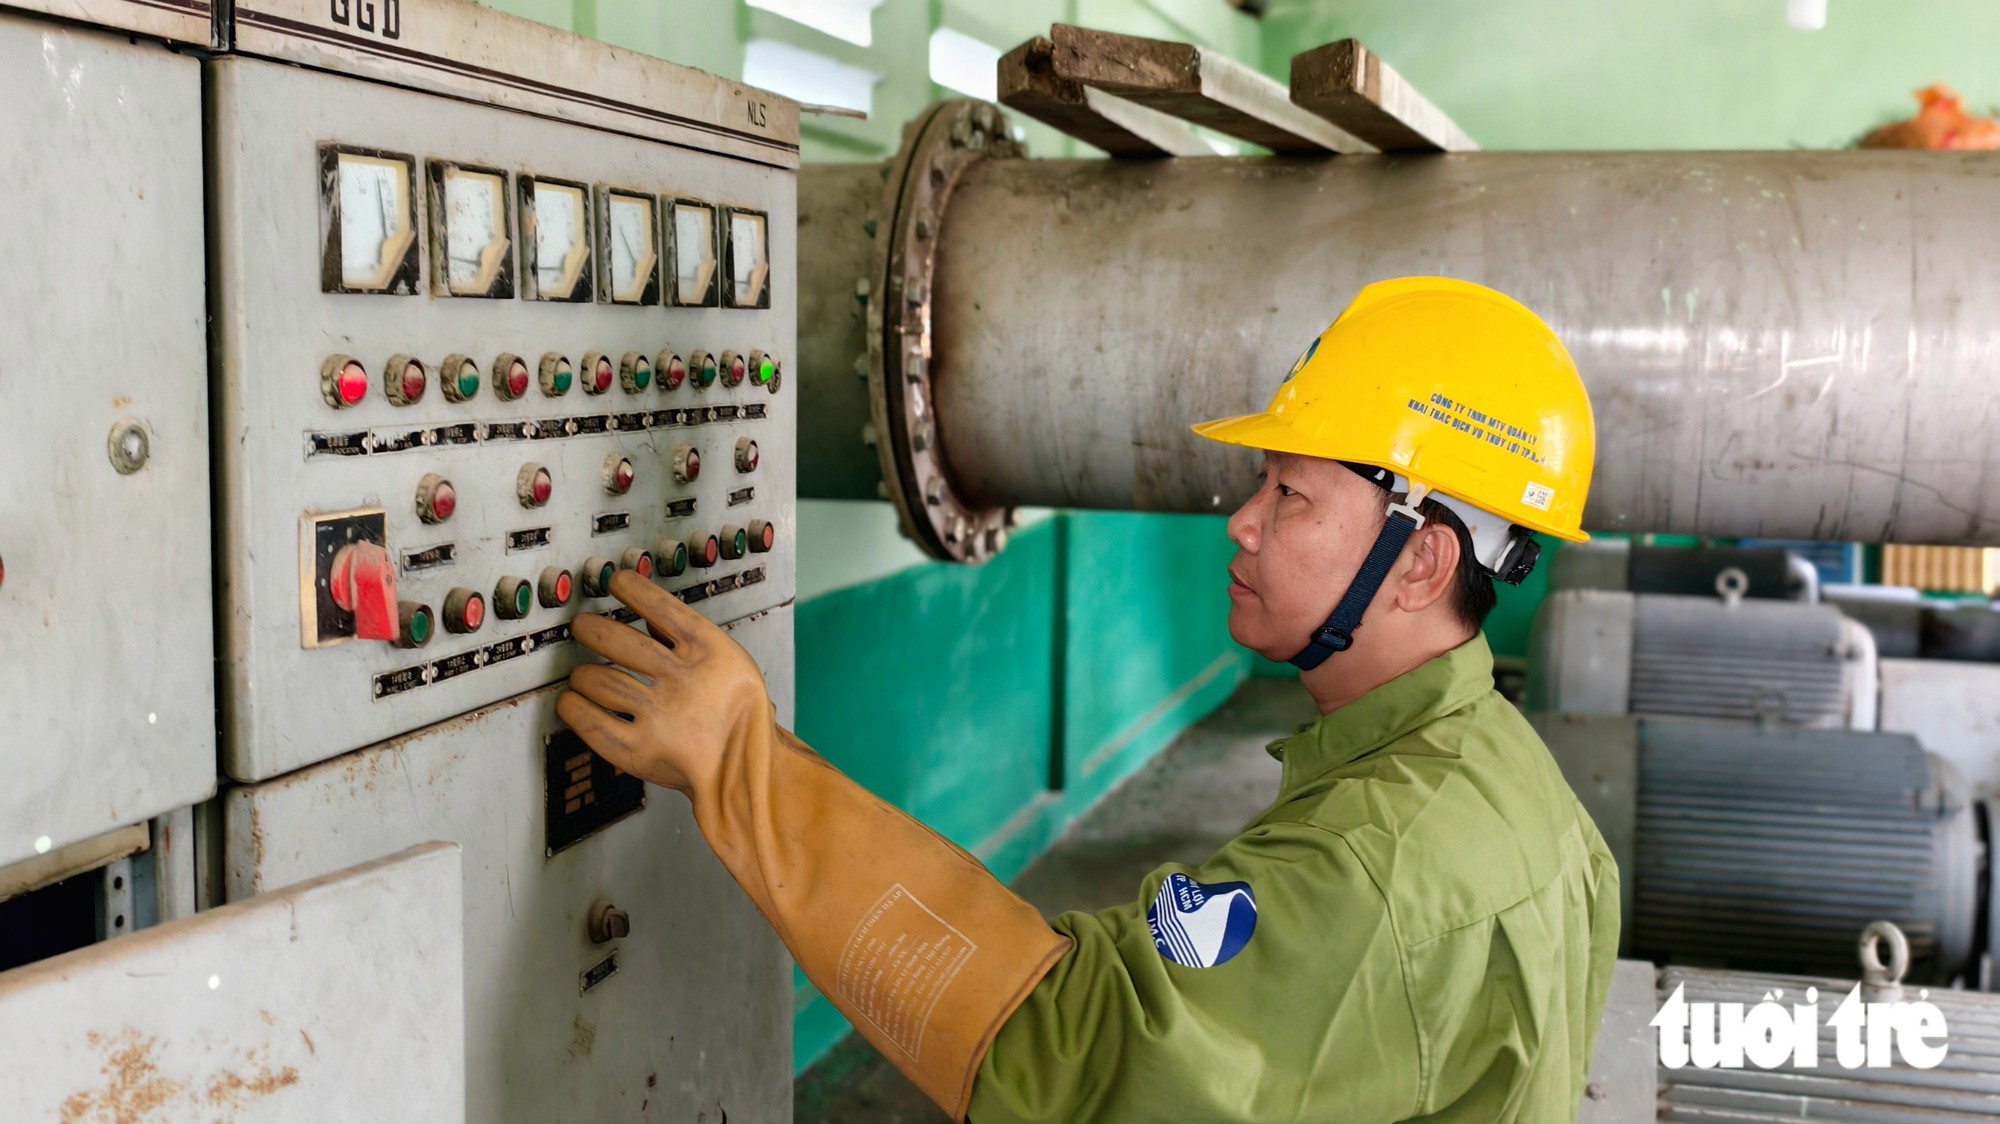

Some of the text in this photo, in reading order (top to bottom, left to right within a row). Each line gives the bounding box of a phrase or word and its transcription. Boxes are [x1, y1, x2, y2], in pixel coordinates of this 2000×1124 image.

[330, 0, 399, 39] GGD
[747, 99, 766, 127] NLS
[1407, 398, 1428, 415] KHAI
[1429, 408, 1452, 425] THÁC
[1472, 427, 1484, 440] VỤ
[1430, 392, 1453, 410] CÔNG
[1454, 402, 1466, 414] TY
[1467, 408, 1487, 424] TNHH
[1487, 417, 1506, 432] MTV
[1178, 886, 1193, 911] HCM
[1191, 889, 1205, 906] LỢI
